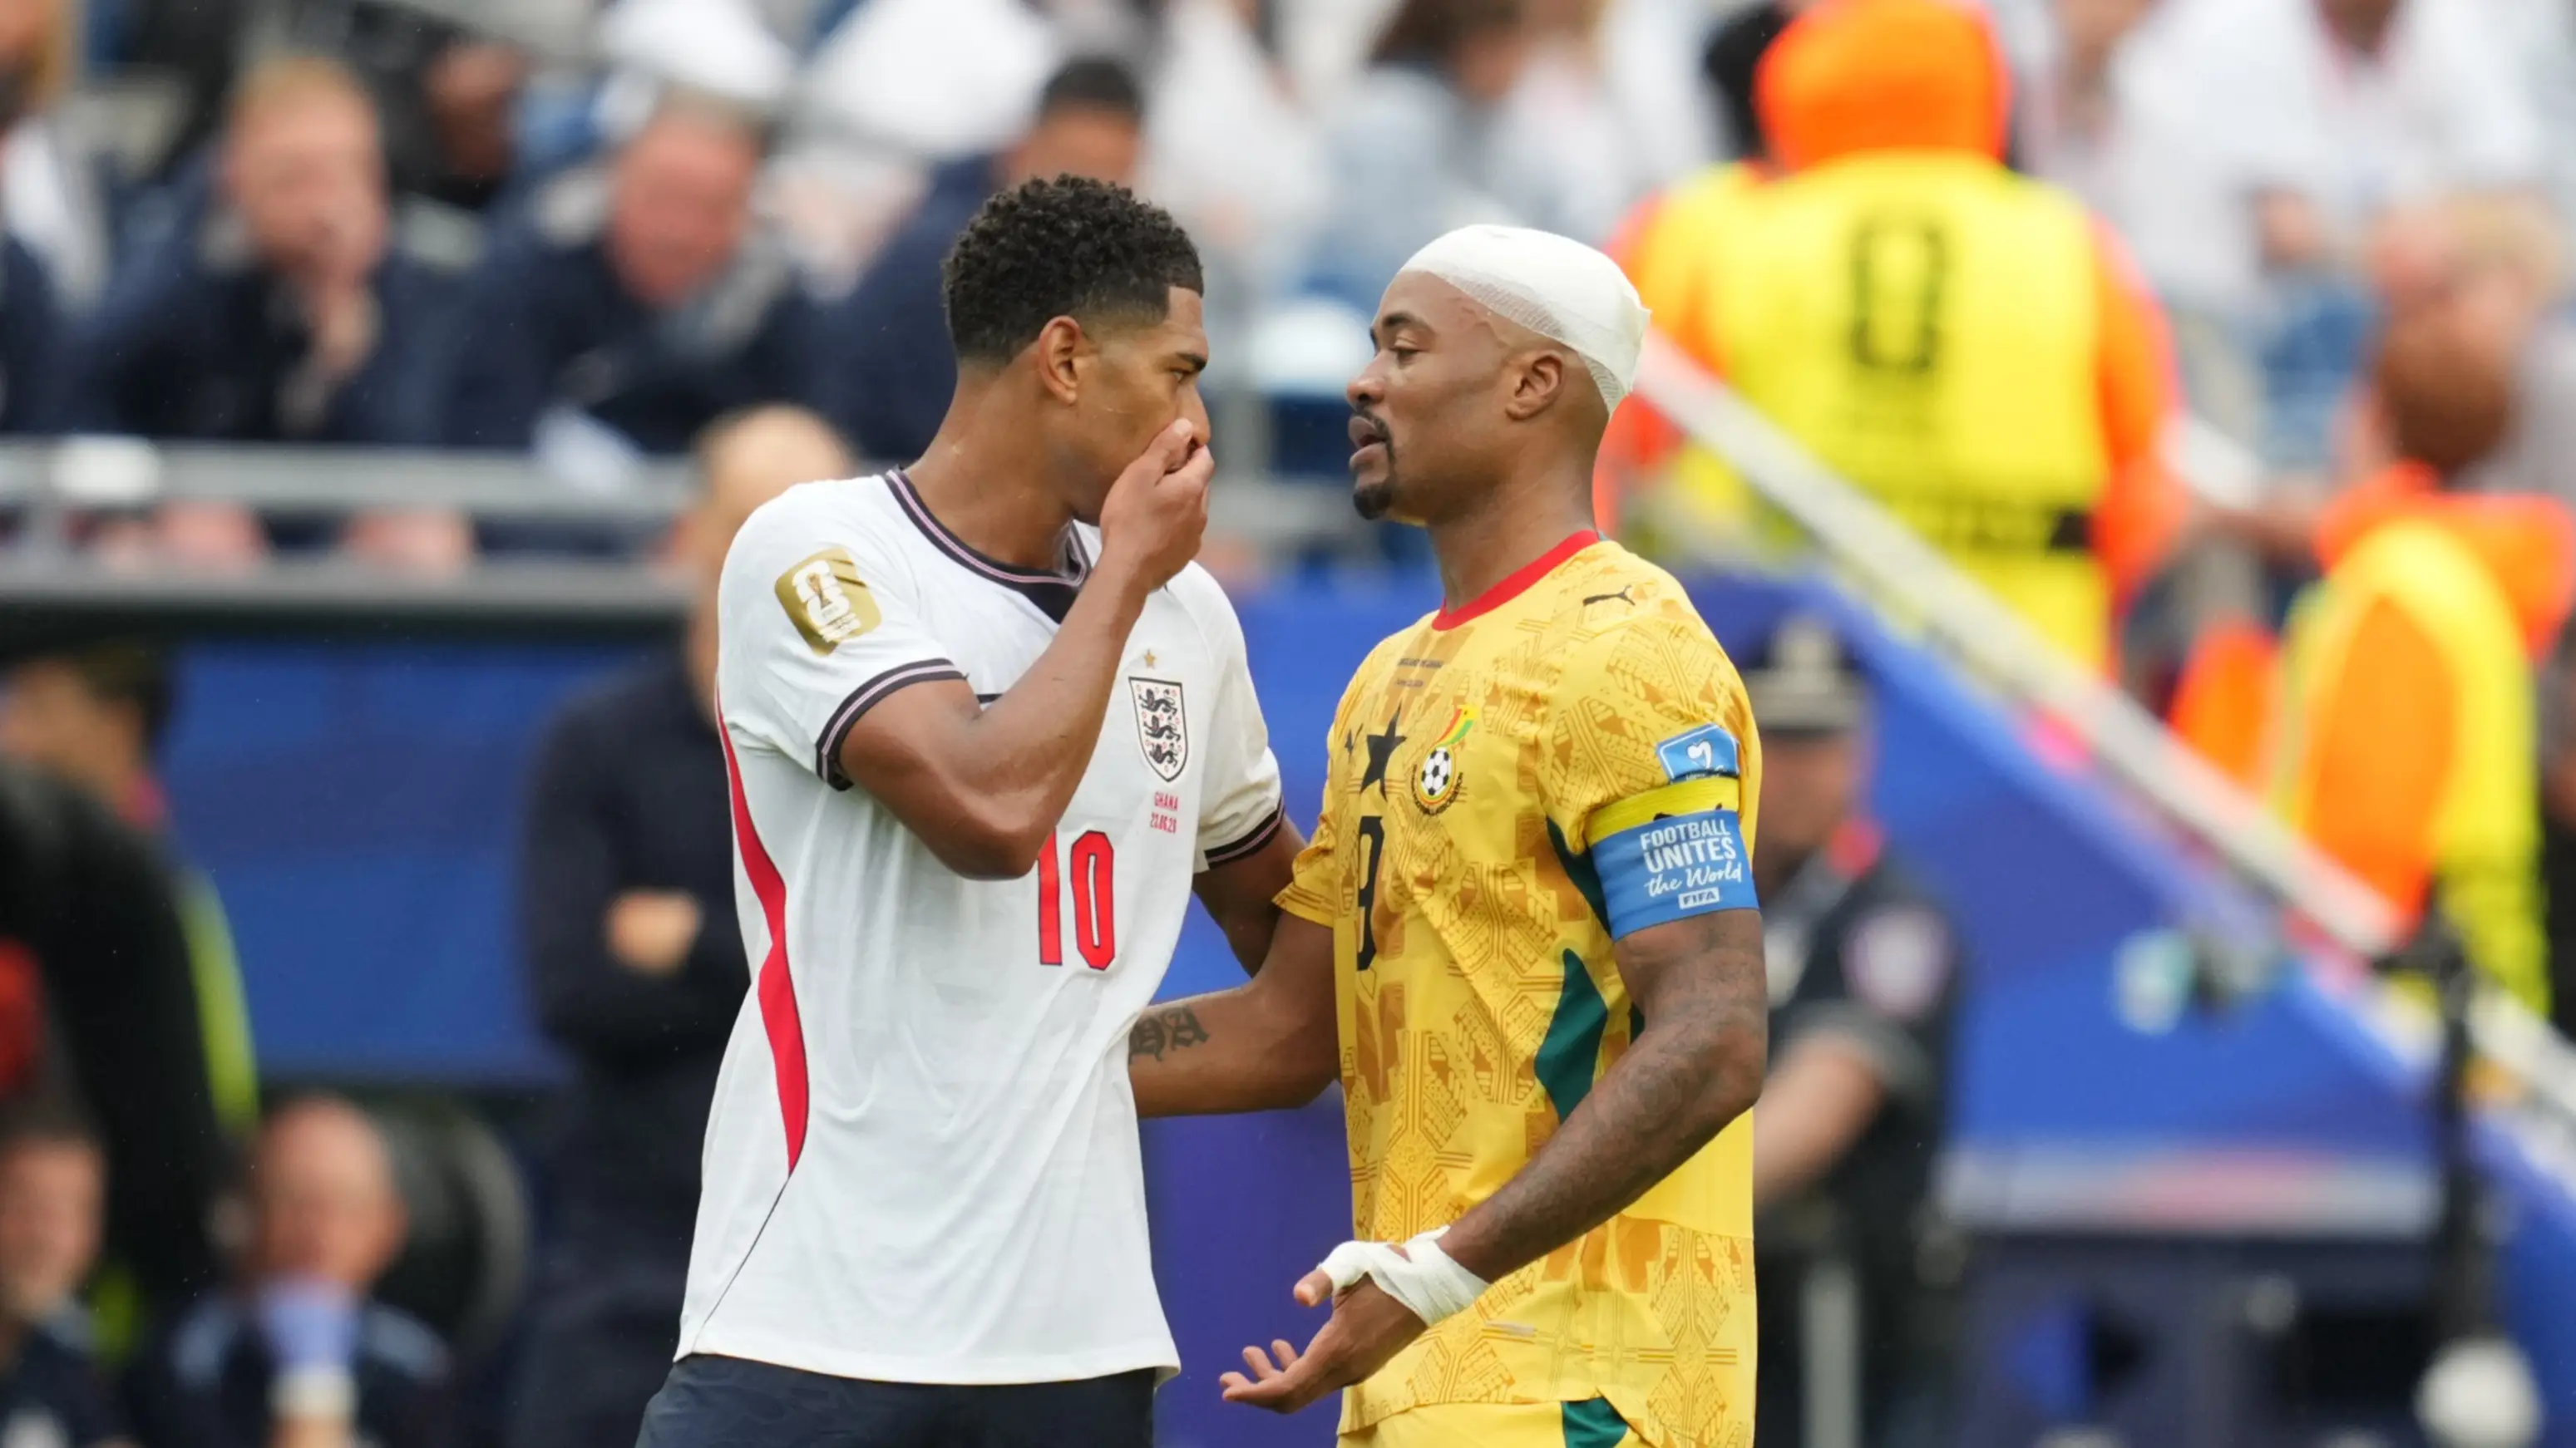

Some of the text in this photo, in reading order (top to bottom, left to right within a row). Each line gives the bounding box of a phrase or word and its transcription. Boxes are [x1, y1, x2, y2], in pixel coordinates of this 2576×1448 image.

[1640, 819, 1731, 850] FOOTBALL
[1644, 836, 1737, 873] UNITES
[1356, 815, 1385, 971] 9
[1643, 861, 1742, 898] the World
[1680, 889, 1719, 907] FIFA
[1038, 826, 1116, 971] 10
